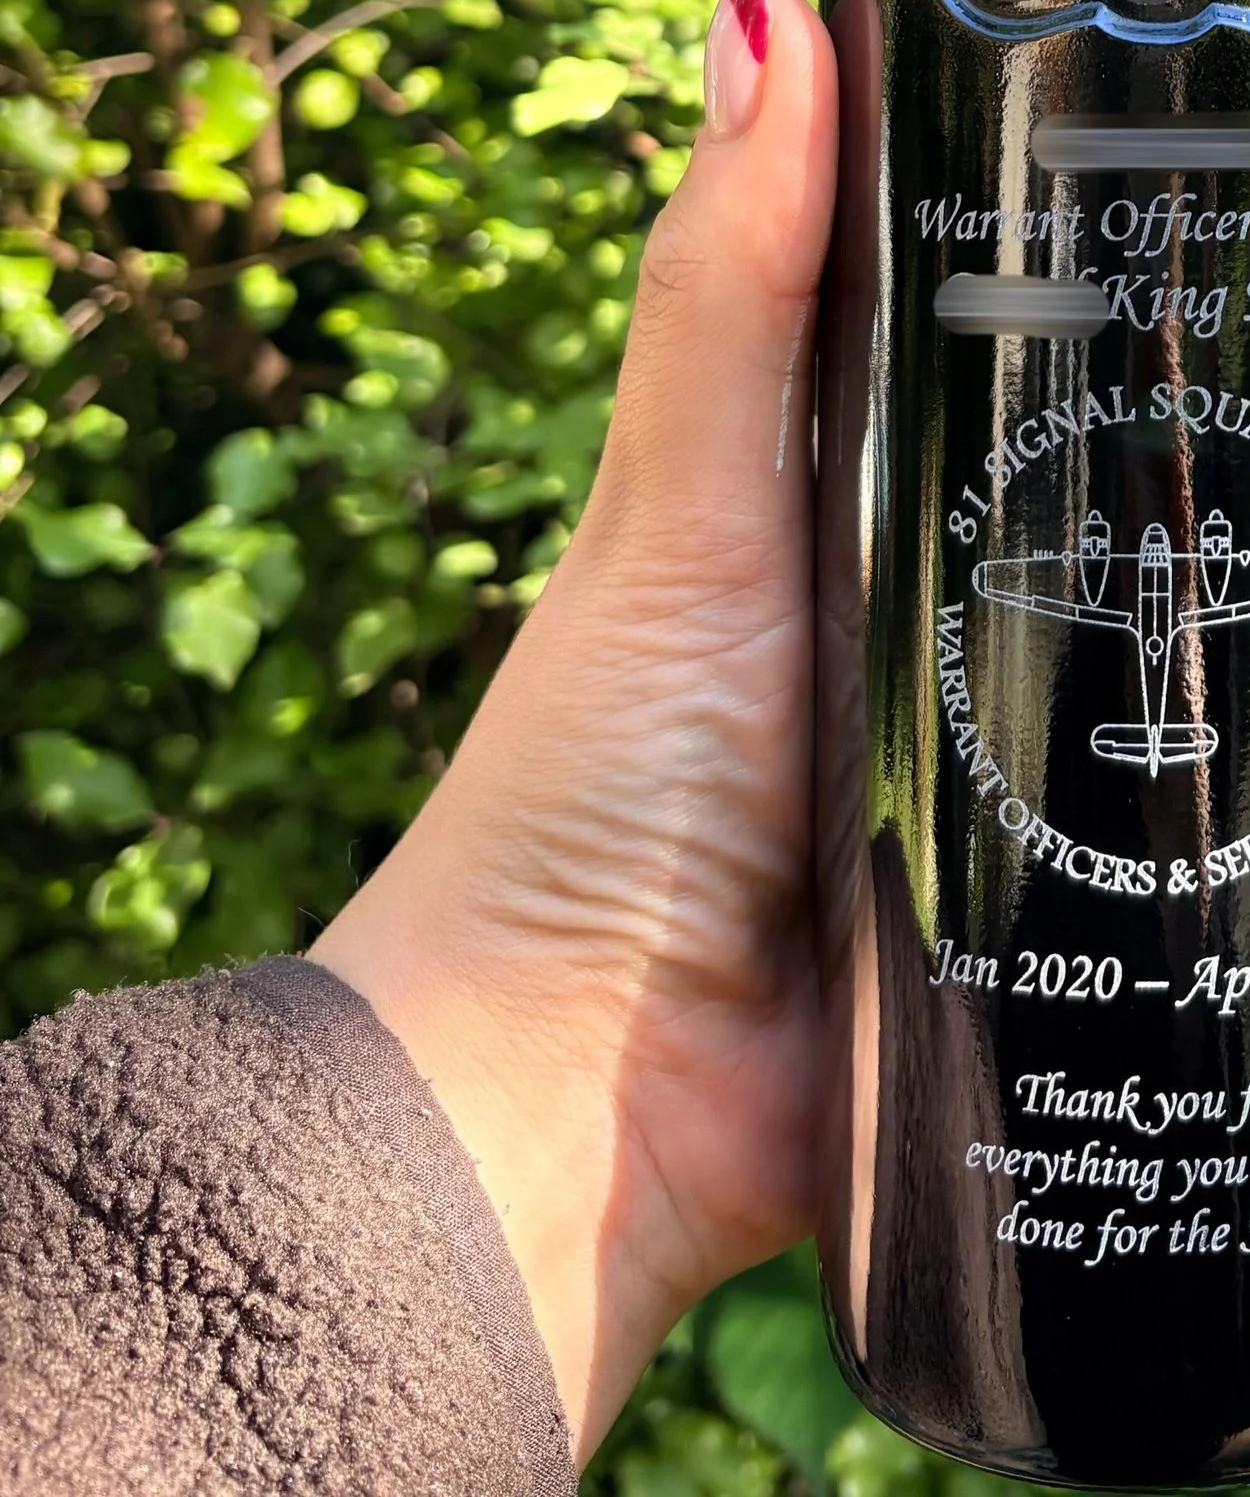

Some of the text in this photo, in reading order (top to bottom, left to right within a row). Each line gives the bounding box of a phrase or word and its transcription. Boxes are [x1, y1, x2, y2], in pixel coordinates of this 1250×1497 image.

[914, 192, 1085, 242] Warrant
[1102, 272, 1231, 340] King
[948, 484, 992, 545] 81
[984, 385, 1137, 489] SIGNAL
[937, 601, 1009, 796] WARRANT
[999, 797, 1158, 896] OFFICERS
[1167, 857, 1199, 895] &
[929, 938, 1000, 988] Jan
[1012, 949, 1124, 1001] 2020
[1016, 1070, 1167, 1135] Thank
[1154, 1087, 1227, 1134] you
[966, 1140, 1162, 1202] everything
[1171, 1156, 1249, 1202] you
[996, 1200, 1084, 1250] done
[1084, 1208, 1159, 1266] for
[1169, 1208, 1231, 1254] the
